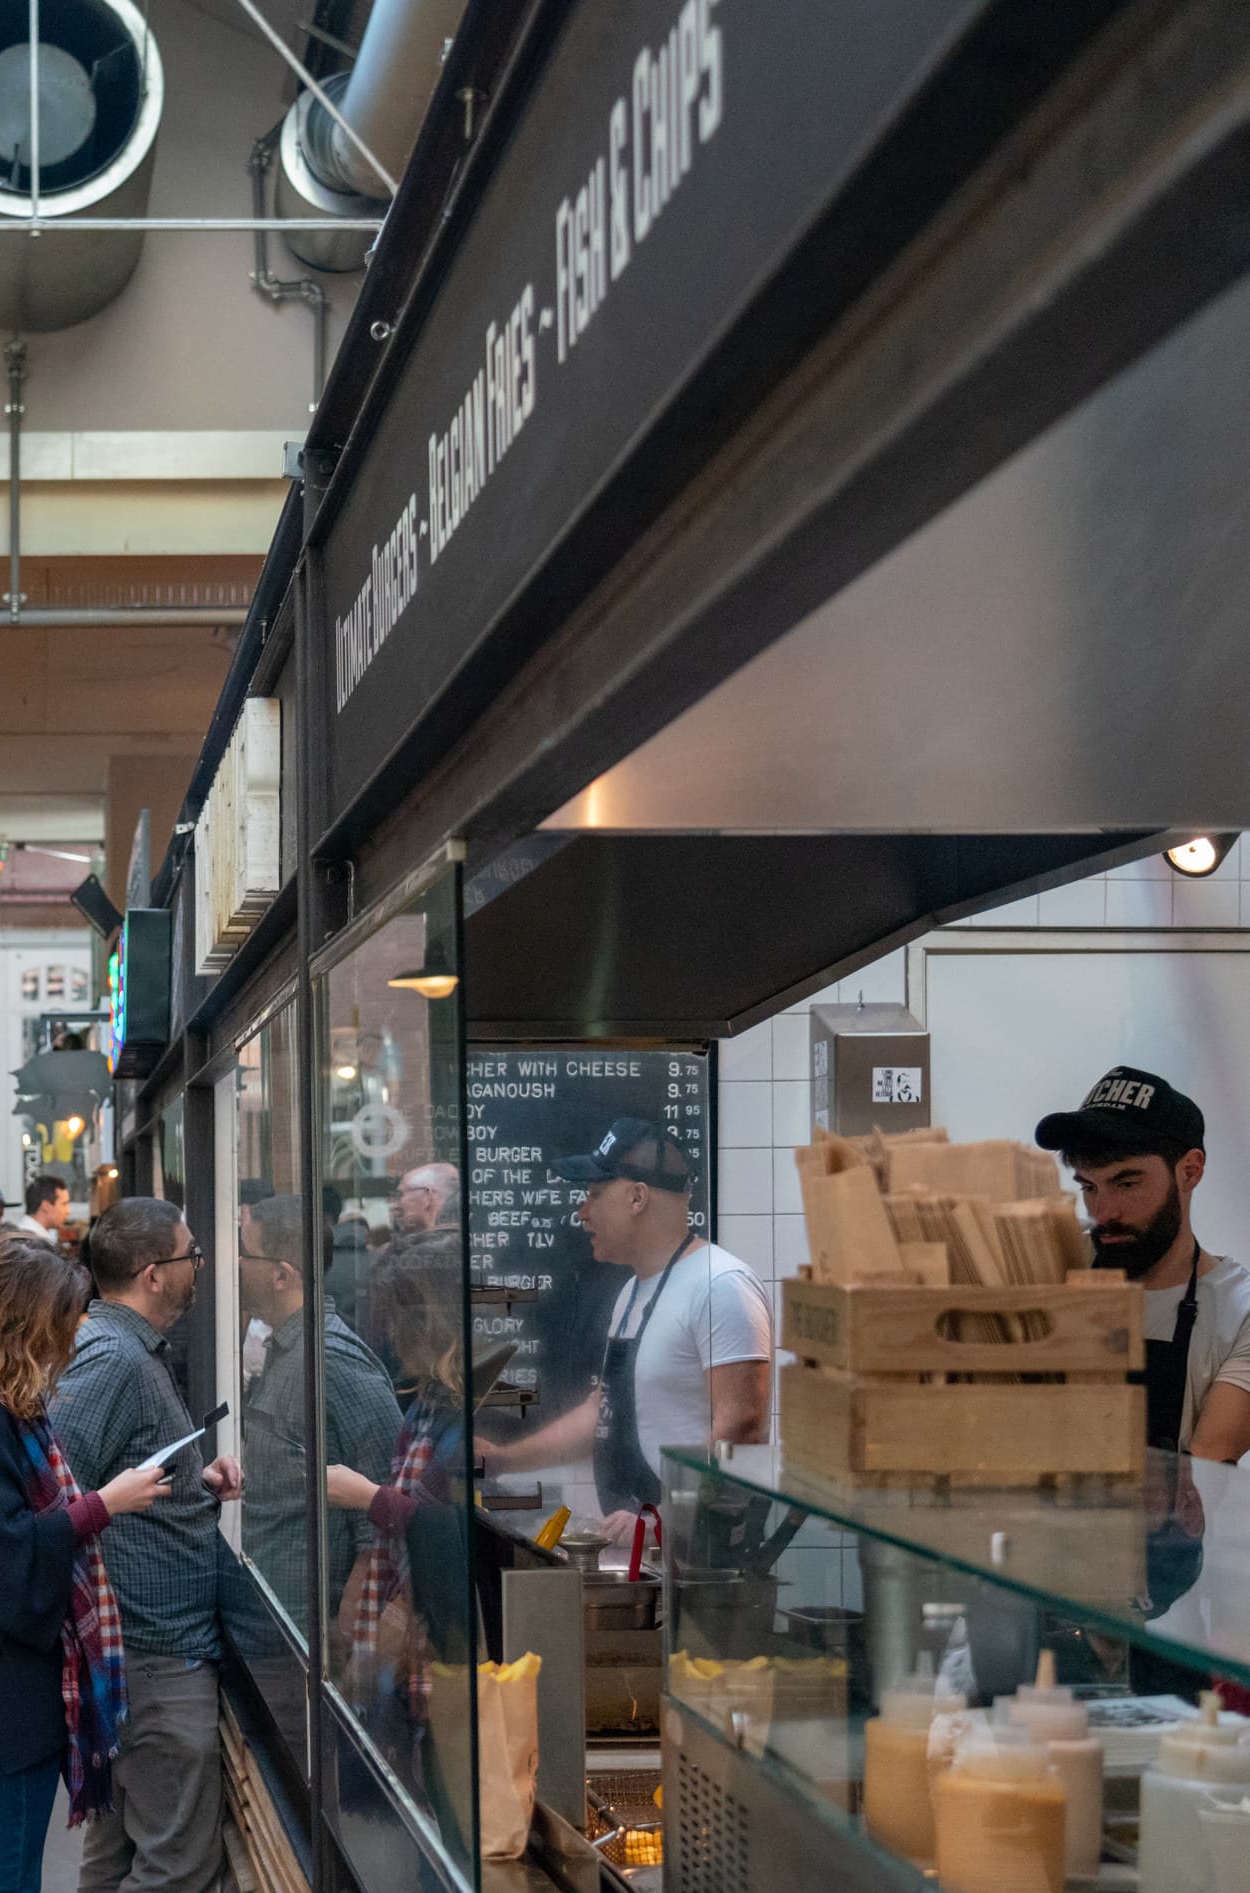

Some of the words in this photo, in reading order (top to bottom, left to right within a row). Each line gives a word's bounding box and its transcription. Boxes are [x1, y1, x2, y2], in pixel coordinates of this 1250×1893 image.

[336, 574, 373, 714] ULTIMATE
[372, 493, 417, 644] BURGERS
[428, 367, 486, 566] BELGIAN
[487, 282, 537, 478] FRIES
[556, 155, 606, 365] FISH
[609, 95, 631, 283] &
[632, 0, 726, 244] CHIPS
[518, 1061, 557, 1077] WITH
[566, 1061, 641, 1077] CHEESE
[476, 1147, 543, 1162] BURGER
[472, 1169, 496, 1183] OF
[502, 1169, 532, 1183] THE
[521, 1191, 562, 1205] WIFE
[488, 1211, 532, 1226] BEEF
[473, 1317, 524, 1334] GLORY
